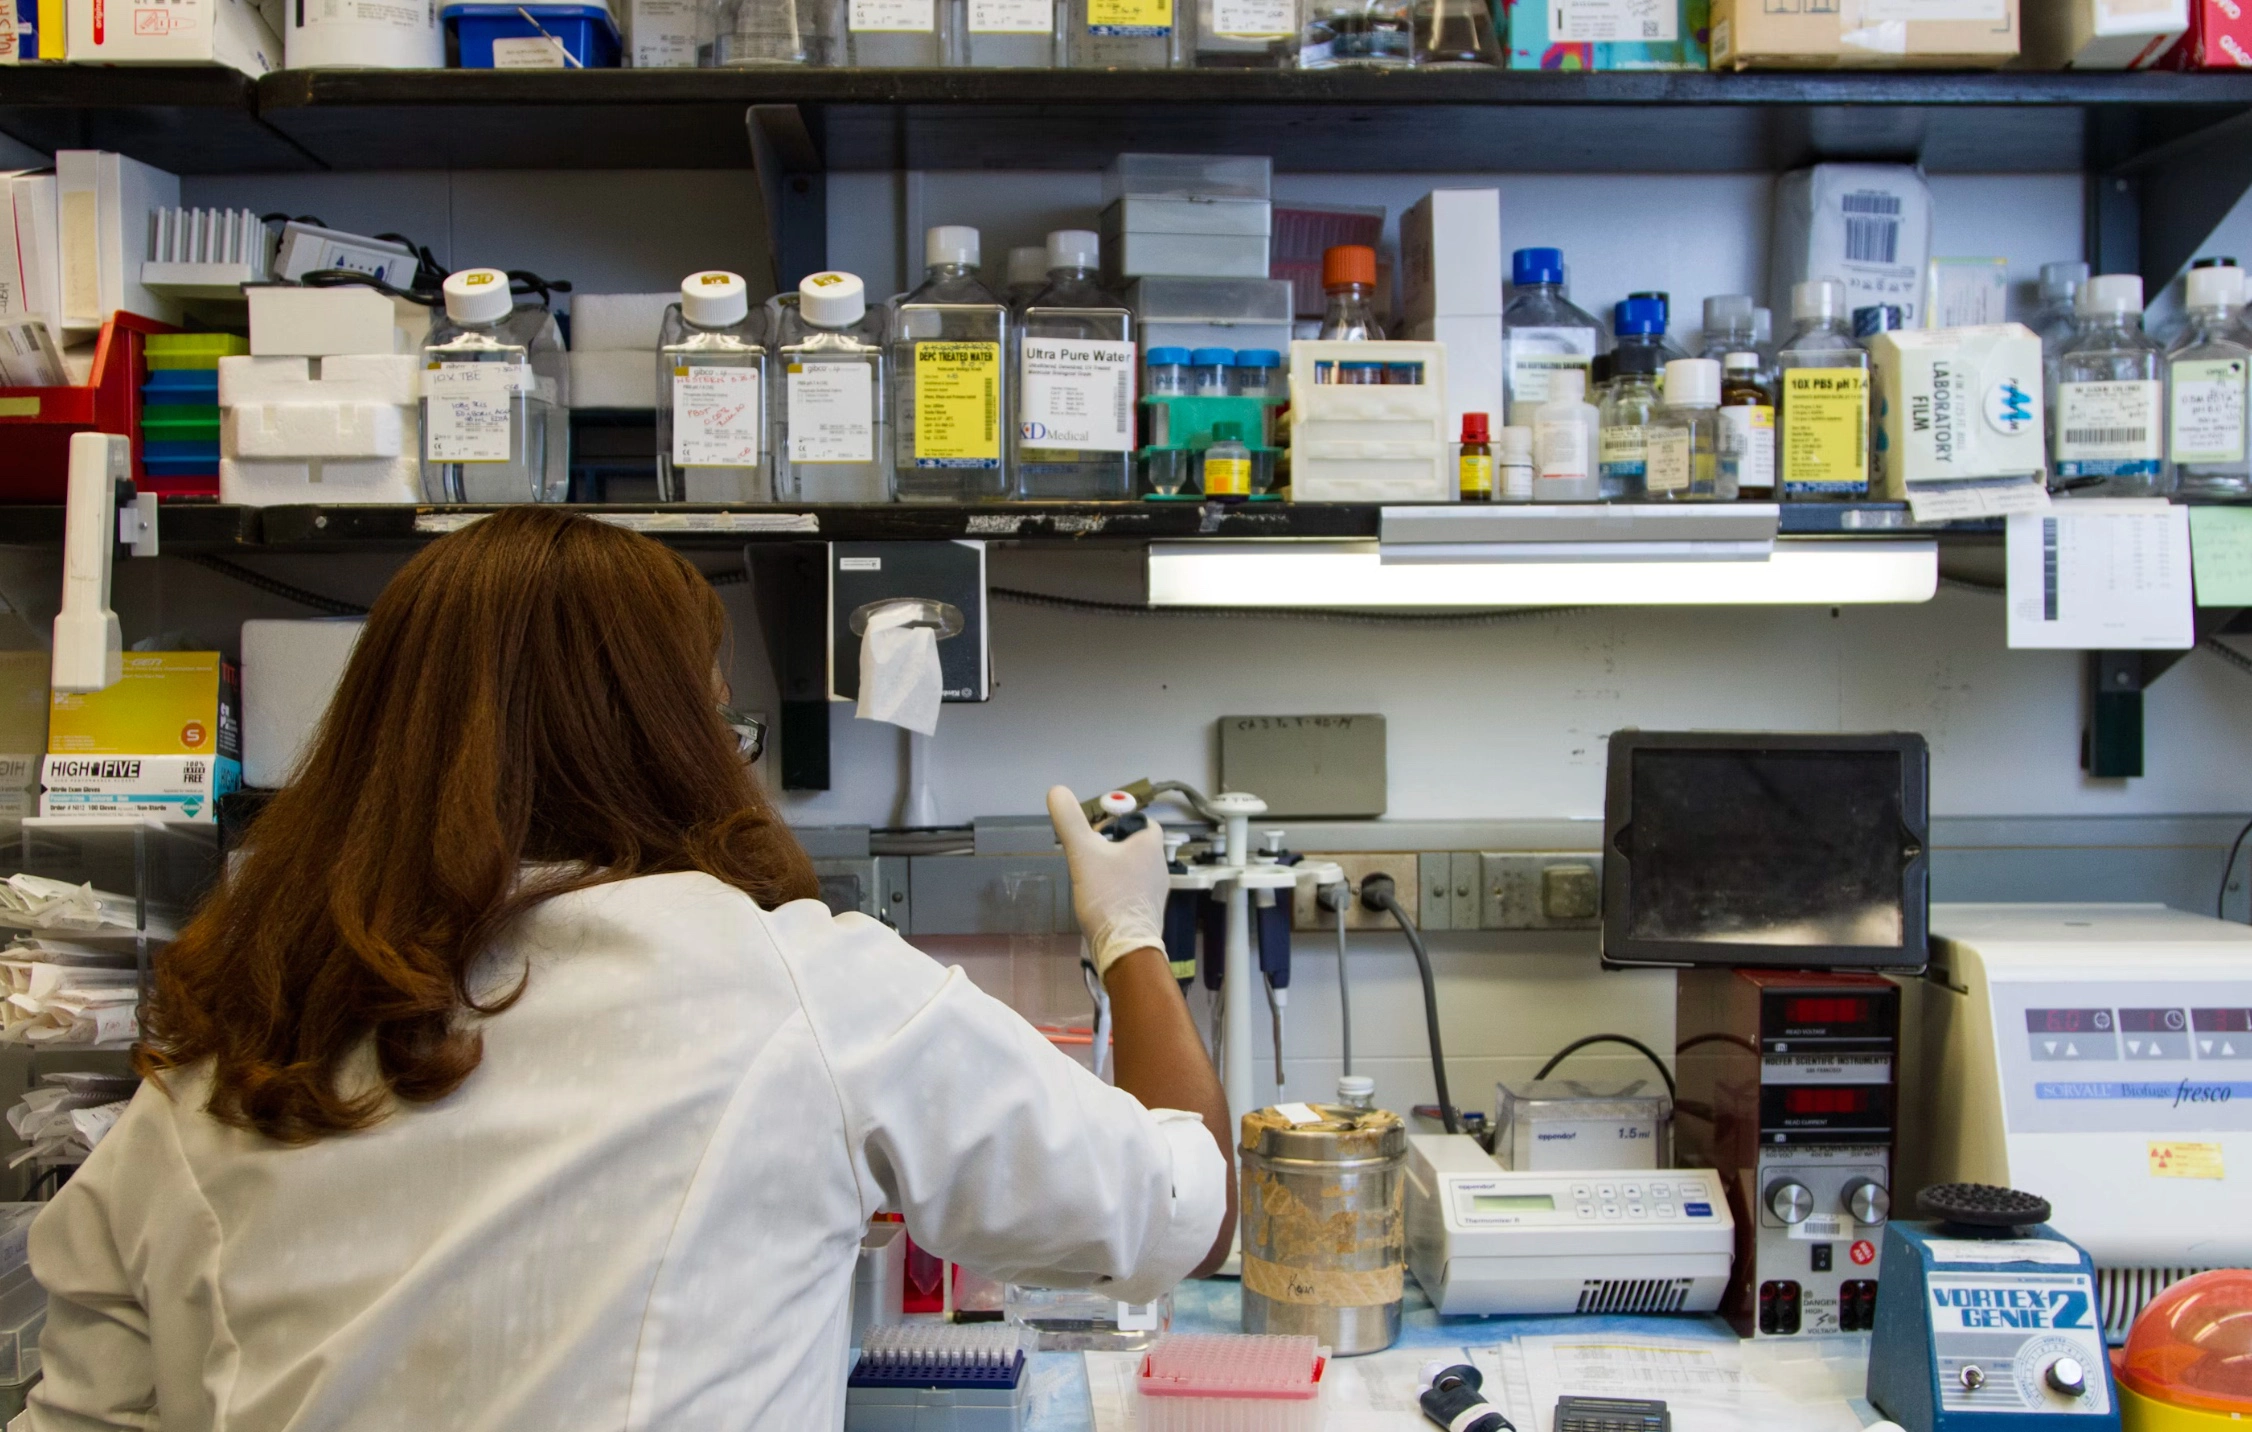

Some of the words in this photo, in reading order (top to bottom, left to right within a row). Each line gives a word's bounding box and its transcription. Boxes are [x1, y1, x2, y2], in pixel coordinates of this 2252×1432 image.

[919, 351, 937, 362] DEPC
[939, 351, 968, 362] TREATED
[970, 351, 993, 362] WATER
[1026, 347, 1056, 360] Ultra
[1061, 348, 1089, 361] Pure
[1093, 350, 1131, 363] Water
[694, 368, 714, 376] gibco
[807, 365, 827, 373] gibco
[433, 374, 455, 384] 10X
[459, 371, 481, 382] TBE
[1791, 379, 1811, 390] 10X
[1813, 379, 1833, 390] PBS
[1836, 378, 1850, 392] pH
[1853, 378, 1868, 389] 7.4
[1912, 395, 1929, 432] FILM
[1933, 361, 1952, 463] LABORATORY
[1047, 428, 1089, 441] Medical
[186, 729, 201, 742] S
[50, 761, 90, 777] HIGH
[103, 761, 140, 777] FIVE
[184, 774, 204, 784] FREE
[1796, 1056, 1834, 1065] SCIENTIFIC
[1837, 1056, 1889, 1065] INSTRUMENTS
[2121, 1083, 2171, 1098] Biofuge
[2173, 1077, 2231, 1109] fresco
[1538, 1131, 1576, 1141] eppendorf
[1618, 1127, 1637, 1139] 1.5
[1638, 1130, 1650, 1139] ml
[1803, 1299, 1837, 1307] DANGER
[2048, 1290, 2094, 1329] 2
[1962, 1309, 2050, 1329] GENIE
[2043, 1337, 2066, 1345] VORTEX
